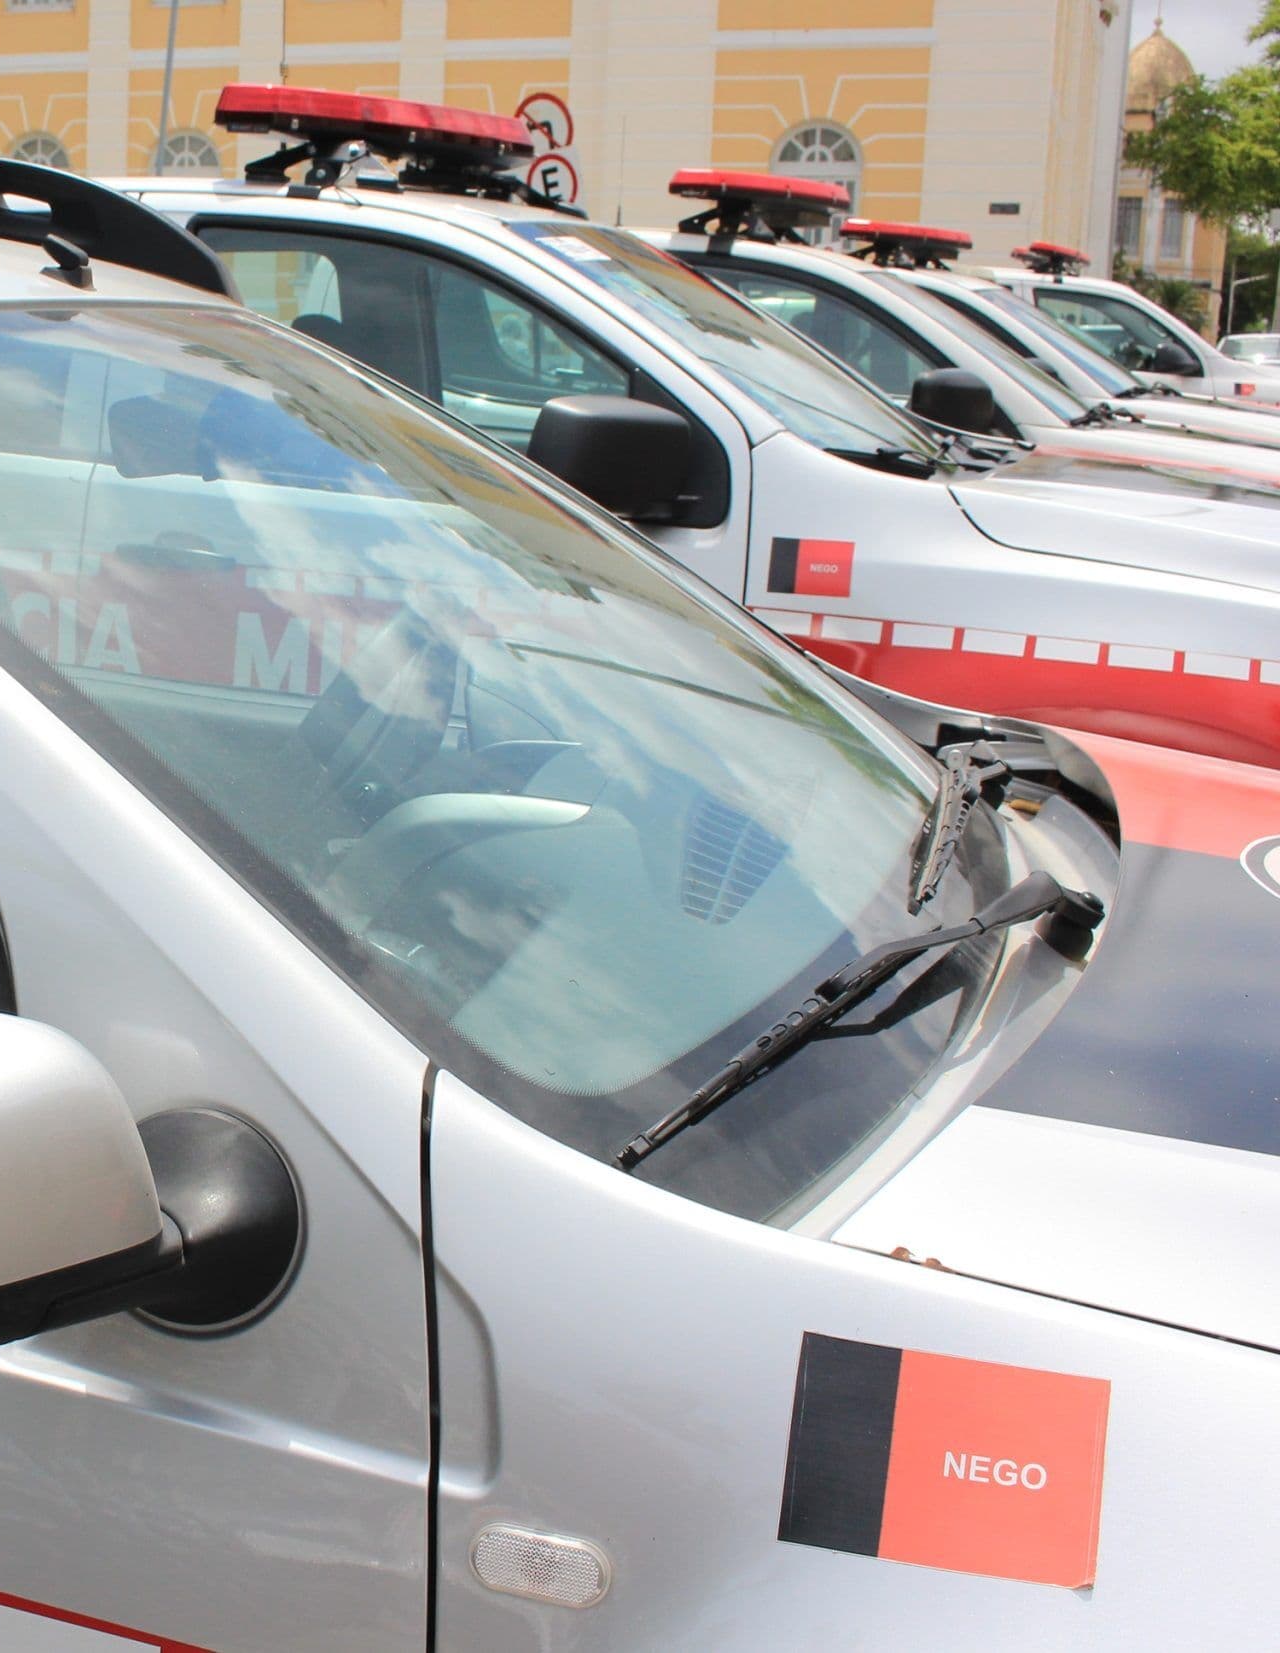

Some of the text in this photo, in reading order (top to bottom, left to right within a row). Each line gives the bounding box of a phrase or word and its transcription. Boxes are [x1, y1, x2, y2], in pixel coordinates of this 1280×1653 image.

[541, 166, 563, 202] E
[810, 563, 838, 574] NEGO
[943, 1450, 1048, 1490] NEGO
